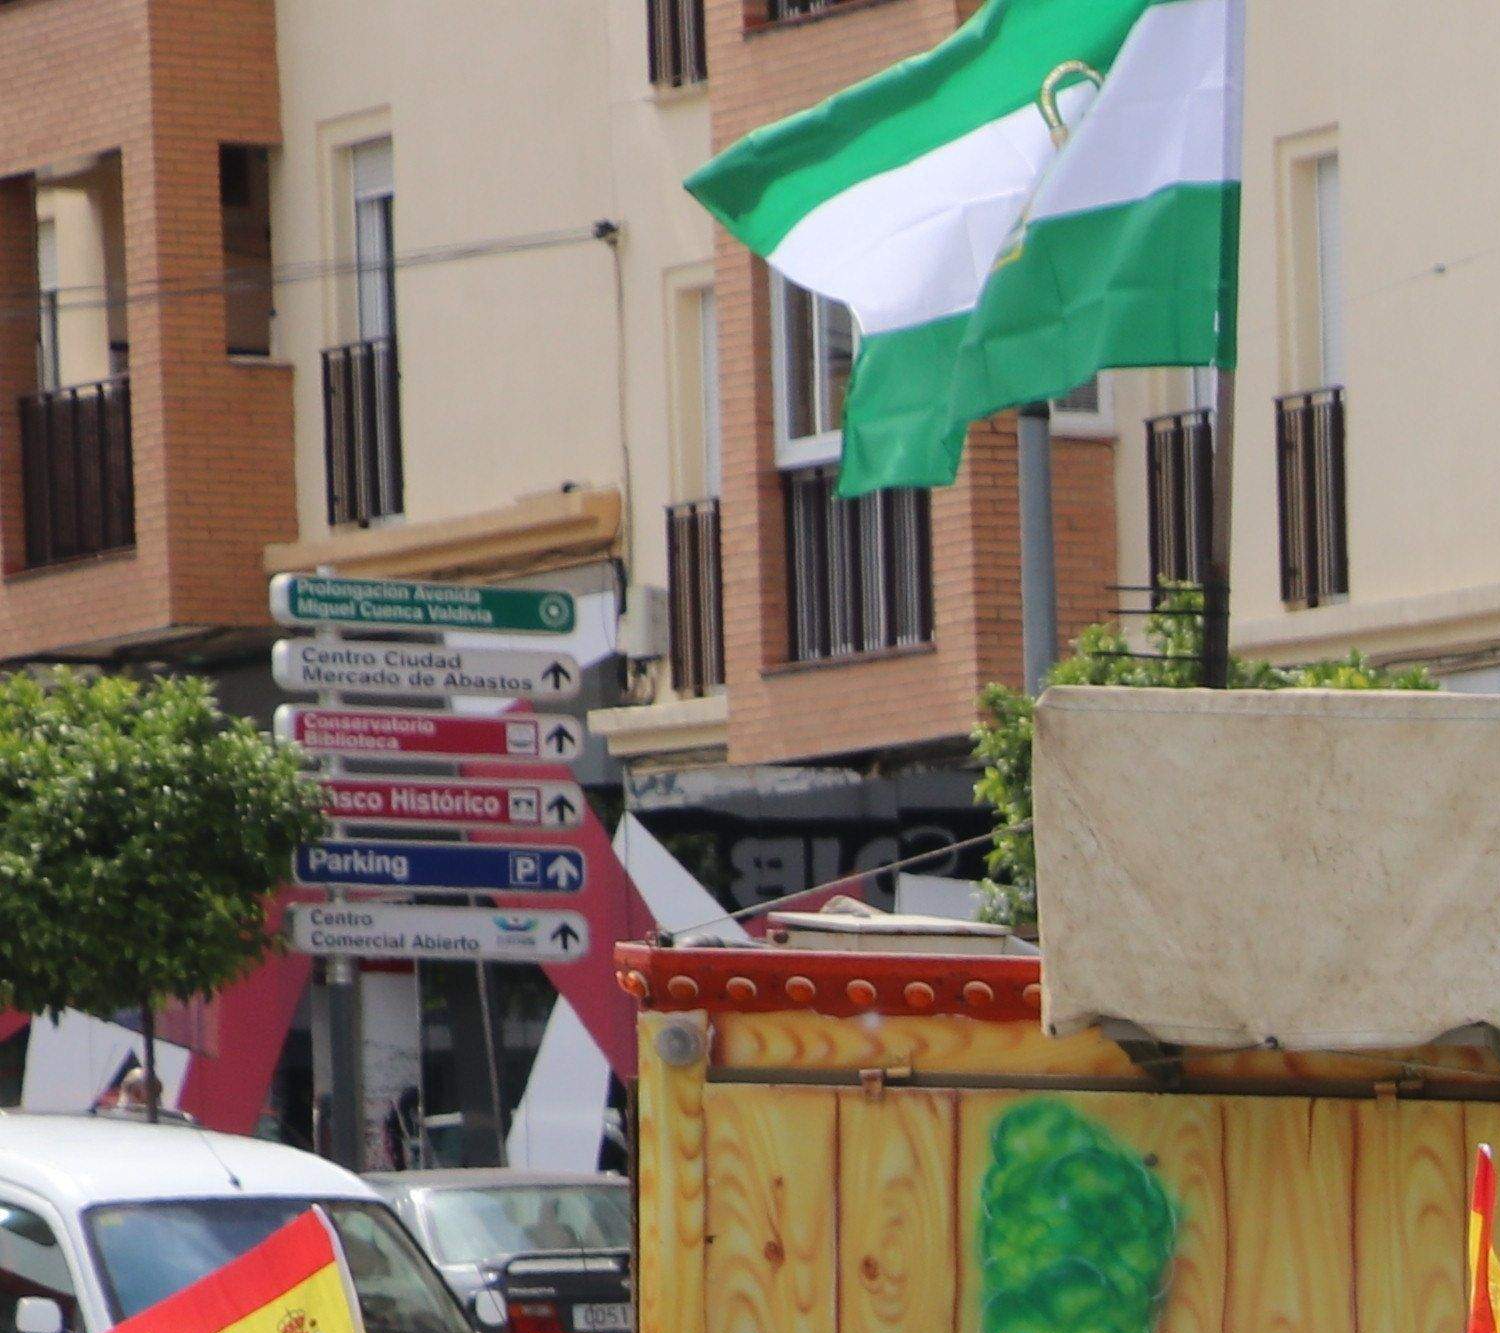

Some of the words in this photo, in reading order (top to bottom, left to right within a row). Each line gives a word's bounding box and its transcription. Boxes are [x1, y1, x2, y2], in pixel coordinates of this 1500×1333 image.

[413, 584, 483, 604] Avenida
[297, 599, 356, 619] Miguel
[360, 602, 424, 621] Cuenca
[302, 647, 376, 666] Centro
[382, 651, 463, 670] Ciudad
[302, 664, 401, 686] Mercado
[408, 667, 435, 687] de
[442, 672, 534, 691] Abastos
[303, 713, 436, 735] Conservatorio
[303, 730, 400, 750] Biblioteca
[390, 787, 500, 814] Histórico
[308, 849, 409, 881] Parking
[309, 908, 374, 927] Centro
[309, 930, 405, 950] Comercial
[412, 933, 480, 951] Abierto
